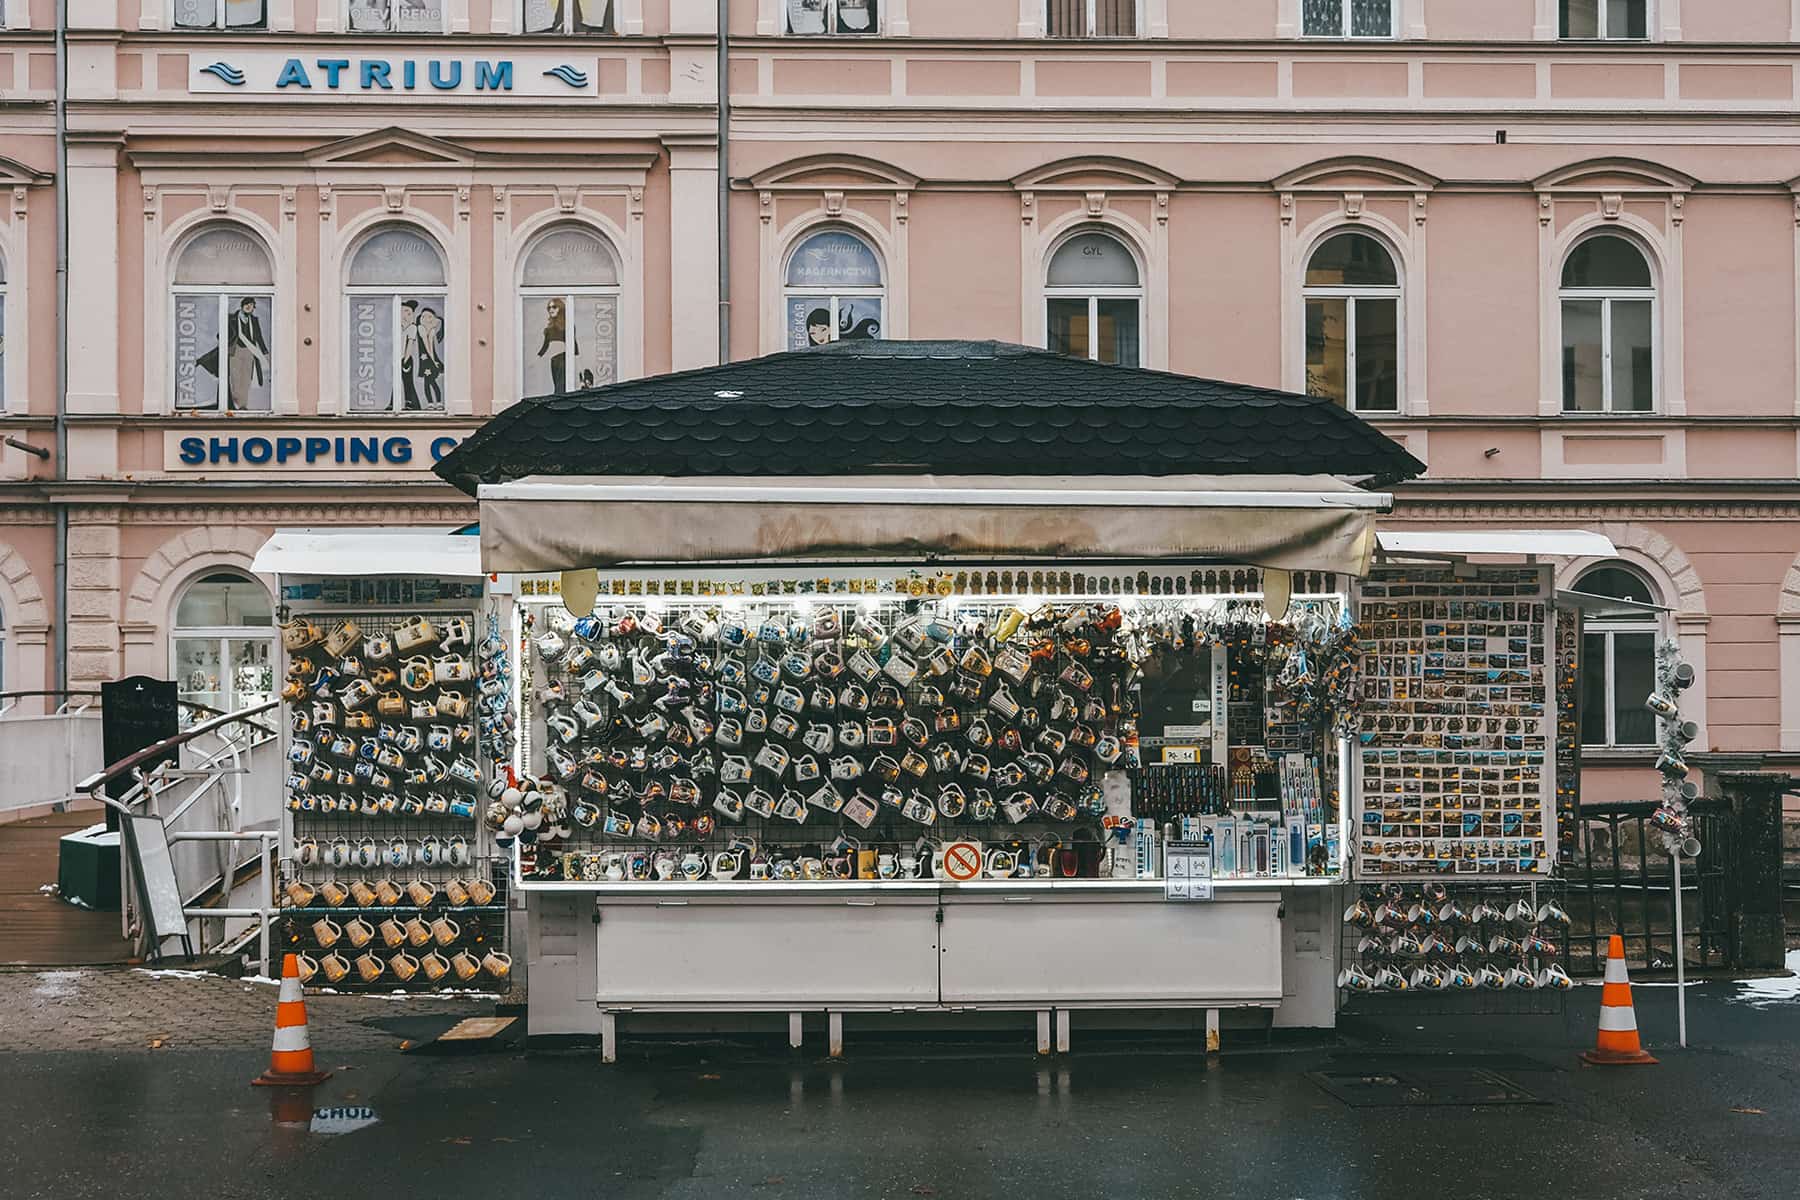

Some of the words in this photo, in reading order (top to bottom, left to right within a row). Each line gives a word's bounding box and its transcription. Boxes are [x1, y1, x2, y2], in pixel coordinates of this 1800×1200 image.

[276, 59, 513, 90] ATRIUM
[179, 301, 196, 404] FASHION
[358, 303, 375, 406] FASHION
[179, 437, 412, 465] SHOPPING
[430, 437, 458, 463] C
